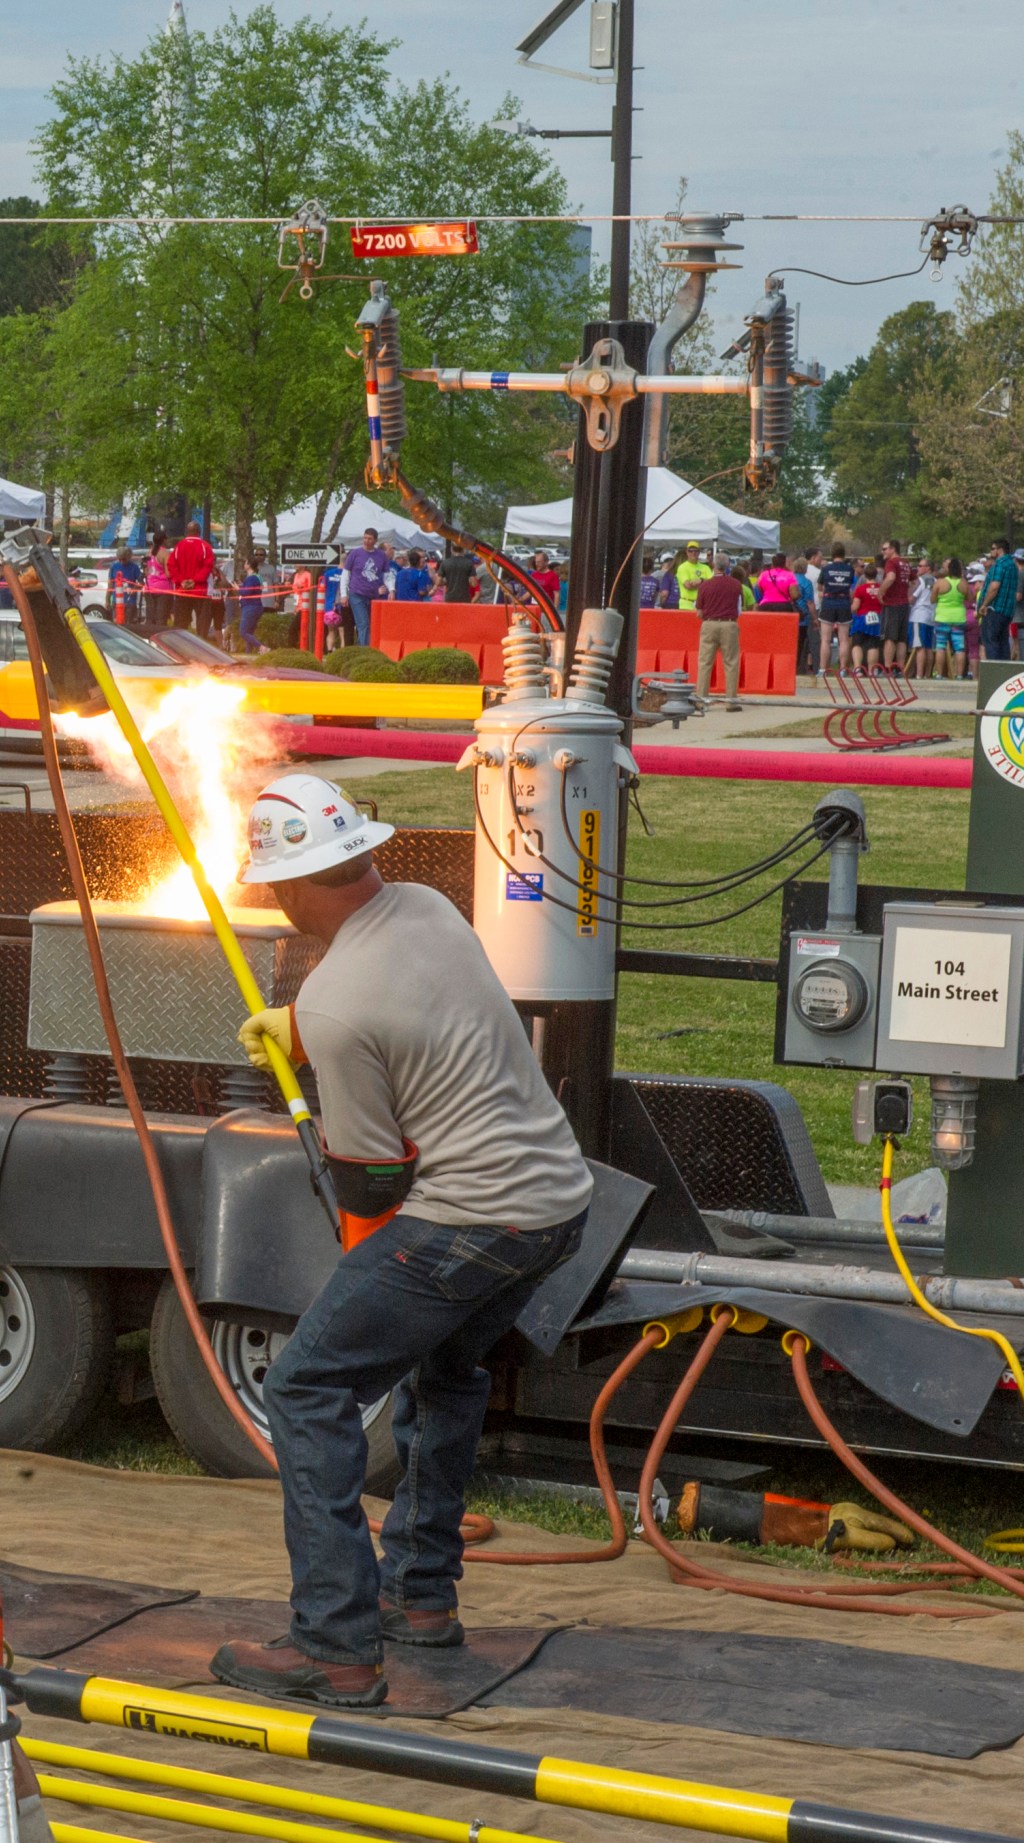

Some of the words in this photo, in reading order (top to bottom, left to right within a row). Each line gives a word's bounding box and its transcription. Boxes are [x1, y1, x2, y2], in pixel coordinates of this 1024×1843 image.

[363, 233, 407, 250] 7200
[408, 231, 465, 248] VOLTS
[287, 551, 305, 559] ONE
[308, 551, 325, 559] WAY
[321, 804, 338, 817] 3M
[507, 829, 544, 857] 10
[934, 960, 965, 976] 104
[897, 982, 940, 999] Main
[945, 985, 999, 1002] Street
